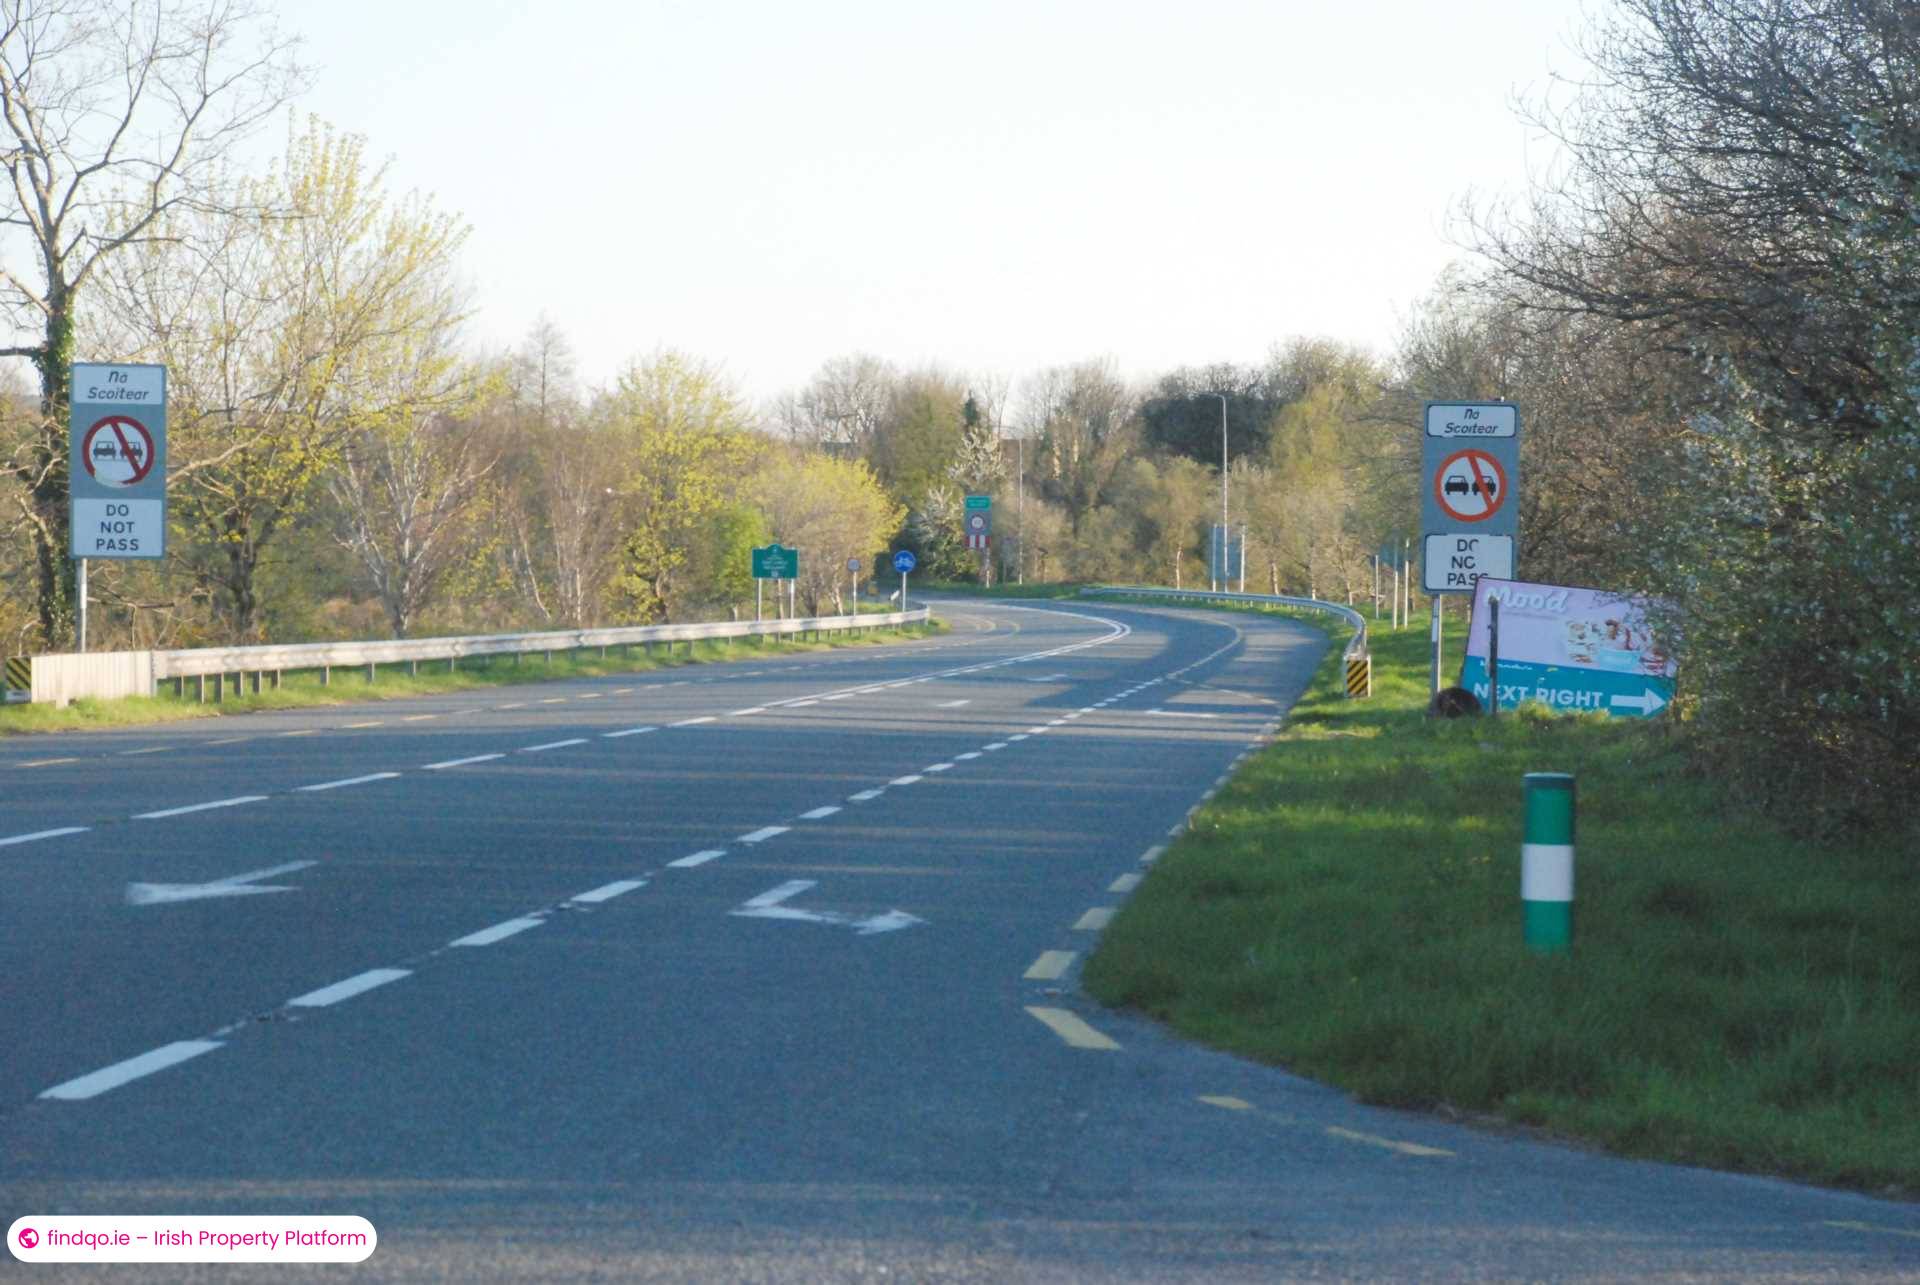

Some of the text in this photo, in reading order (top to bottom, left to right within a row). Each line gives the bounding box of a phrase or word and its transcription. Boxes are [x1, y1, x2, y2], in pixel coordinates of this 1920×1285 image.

[87, 386, 149, 401] Scoitear
[106, 504, 129, 517] DO
[100, 521, 135, 534] NOT
[96, 538, 139, 551] PASS
[1447, 572, 1489, 586] PAS
[1536, 687, 1603, 707] RIGHT
